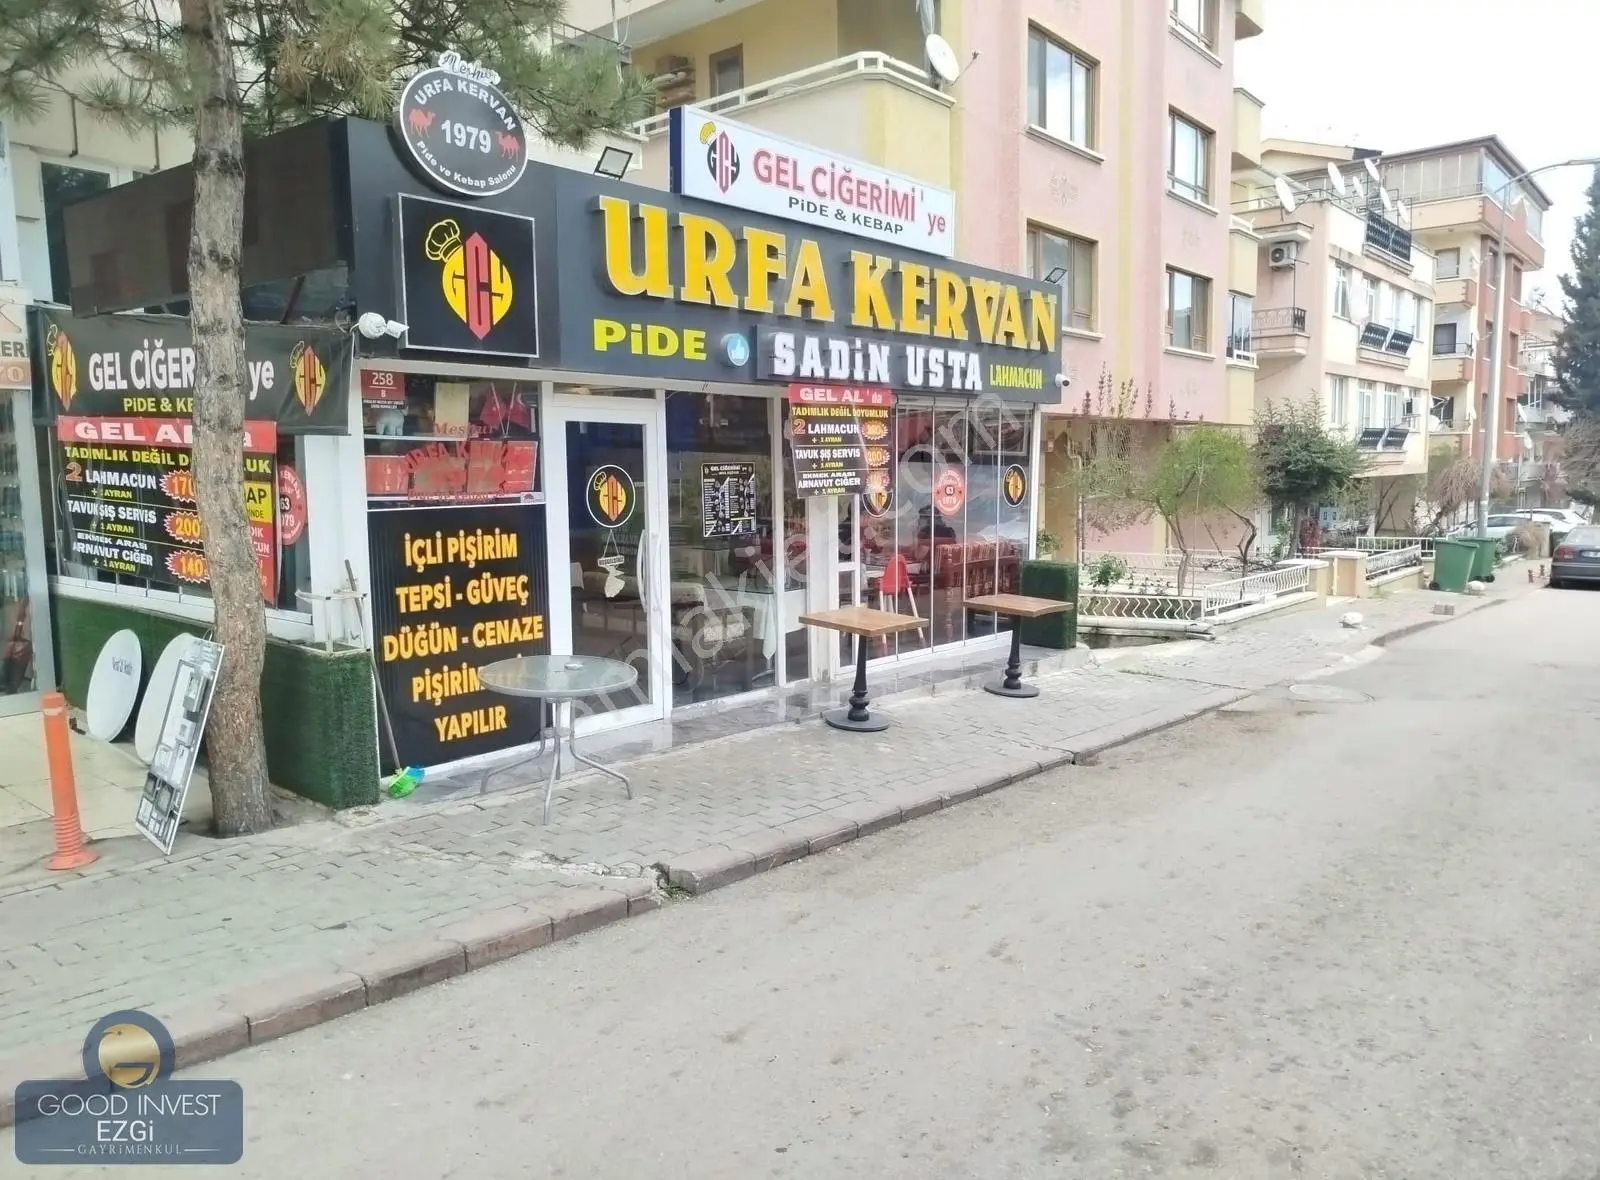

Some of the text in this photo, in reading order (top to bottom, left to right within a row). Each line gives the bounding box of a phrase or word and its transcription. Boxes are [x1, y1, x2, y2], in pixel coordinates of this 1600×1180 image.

[414, 78, 516, 131] URFA KERVAN
[441, 119, 492, 154] 1979
[416, 140, 517, 189] Pide ve Kebap Salonu
[752, 149, 806, 192] GEL
[927, 210, 947, 236] ye
[834, 208, 847, 222] &
[852, 211, 904, 235] KEBAP
[597, 195, 1058, 353] URFA KERVAN
[0, 341, 27, 358] ER
[88, 352, 128, 391] GEL
[905, 344, 983, 391] USTA
[989, 363, 1043, 391] LAHMACUN
[371, 372, 394, 386] 258
[799, 387, 838, 402] GEL
[160, 400, 172, 413] &
[792, 406, 829, 416] TADIMLIK
[74, 421, 148, 442] GEL
[793, 418, 860, 434] 2 LAHMACUN
[795, 449, 819, 460] TAVUK
[65, 461, 157, 490] 2 LAHMACUN
[798, 479, 835, 489] ARNAVUT
[104, 489, 132, 499] AYRAN
[67, 499, 98, 516] TAVUK
[106, 523, 135, 534] AYRAN
[175, 516, 200, 536] 200
[72, 542, 120, 560] ARNAVUT
[76, 532, 148, 551] EKMEK ARASI
[404, 527, 518, 573] İÇLİ PİŞİRİM
[108, 560, 136, 572] AYRAN
[180, 556, 204, 574] 140
[395, 575, 452, 613] TEPSİ
[466, 571, 529, 606] GÜVEÇ
[383, 621, 458, 662] DÜĞÜN
[472, 615, 544, 648] CENAZE
[434, 706, 507, 743] YAPILIR
